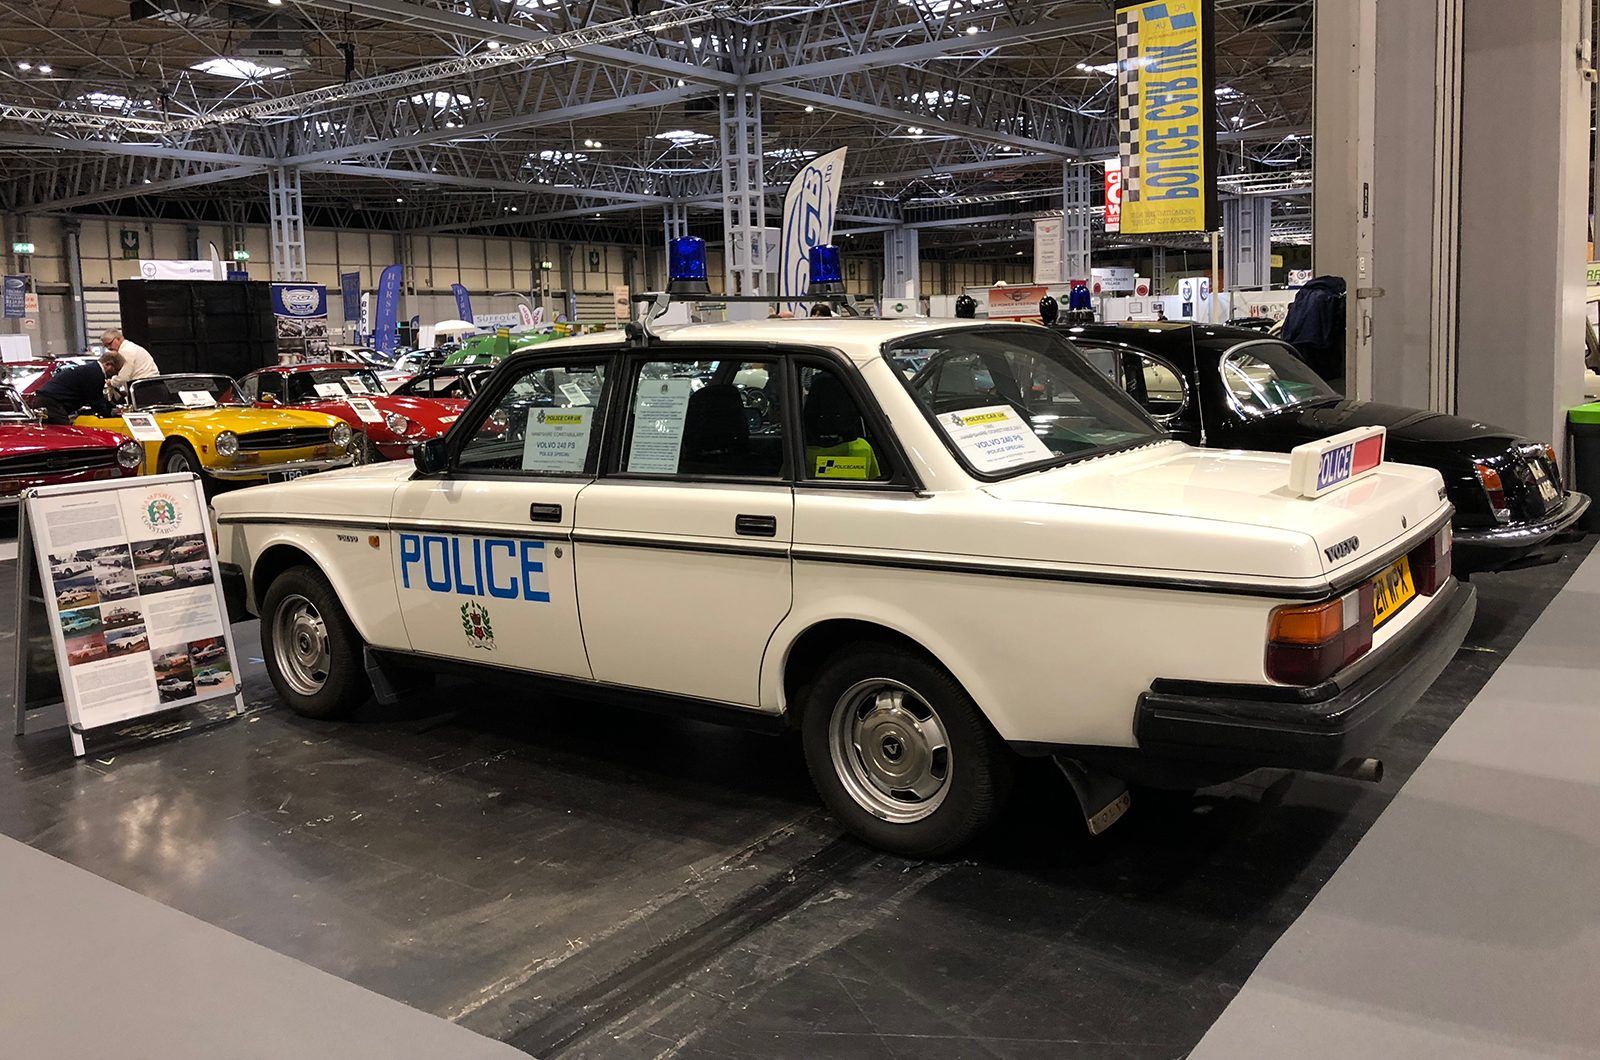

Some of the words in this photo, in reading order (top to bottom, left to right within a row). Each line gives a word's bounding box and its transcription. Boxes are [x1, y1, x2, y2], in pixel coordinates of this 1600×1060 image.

[384, 272, 395, 317] HURST
[477, 314, 517, 323] SUFFOLK
[964, 413, 986, 423] POLICE
[985, 412, 999, 420] CAR
[960, 430, 989, 440] HAMPSHIRE
[974, 438, 1000, 449] VOLVO
[1000, 436, 1014, 444] 240
[1013, 434, 1024, 442] PS
[536, 441, 556, 449] VOLVO
[141, 492, 180, 511] HAMPSHIRE
[141, 509, 183, 535] CONSTABULARY
[1324, 535, 1361, 564] VOLVO
[400, 533, 551, 603] POLICE
[1090, 795, 1129, 829] VOLVO
